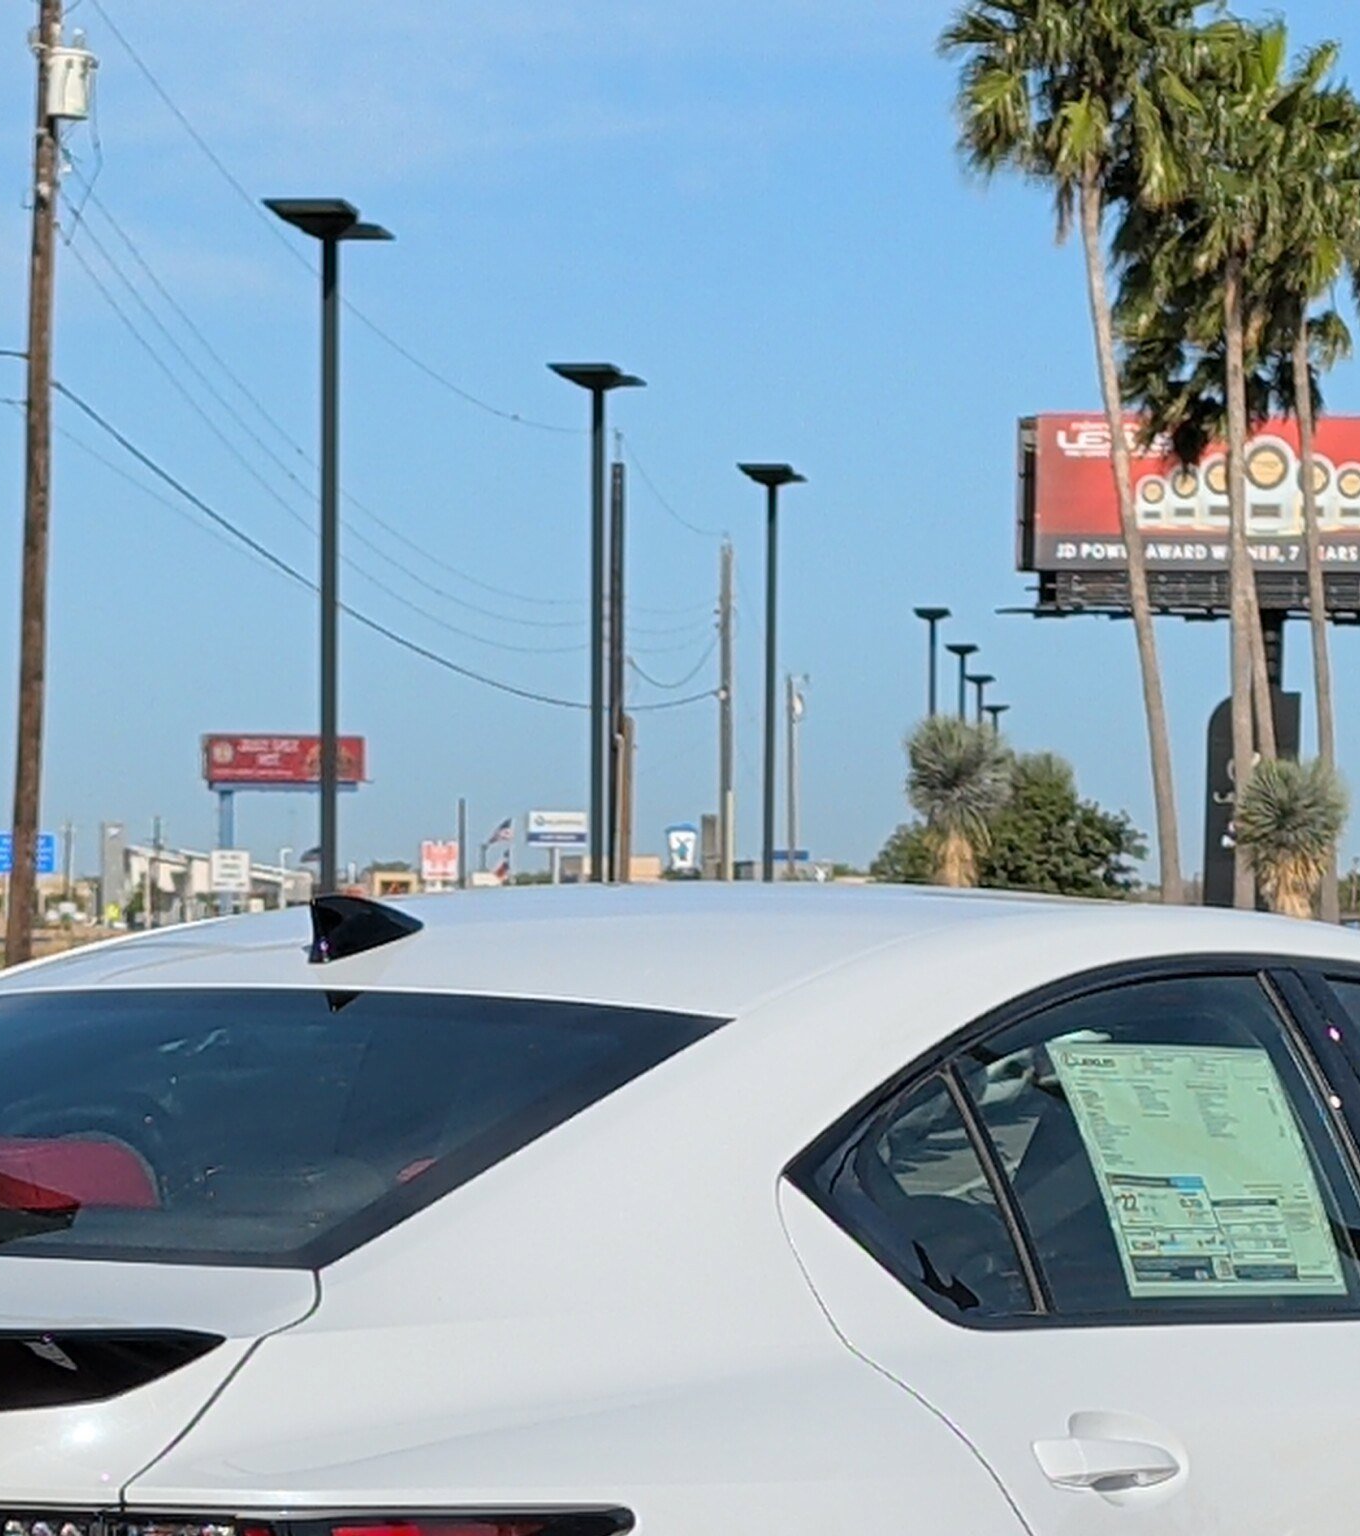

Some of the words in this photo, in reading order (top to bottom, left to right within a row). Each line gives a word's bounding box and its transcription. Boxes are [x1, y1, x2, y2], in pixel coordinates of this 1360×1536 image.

[1080, 543, 1128, 559] POW
[1145, 543, 1208, 560] AWARD
[1288, 545, 1300, 561] 7
